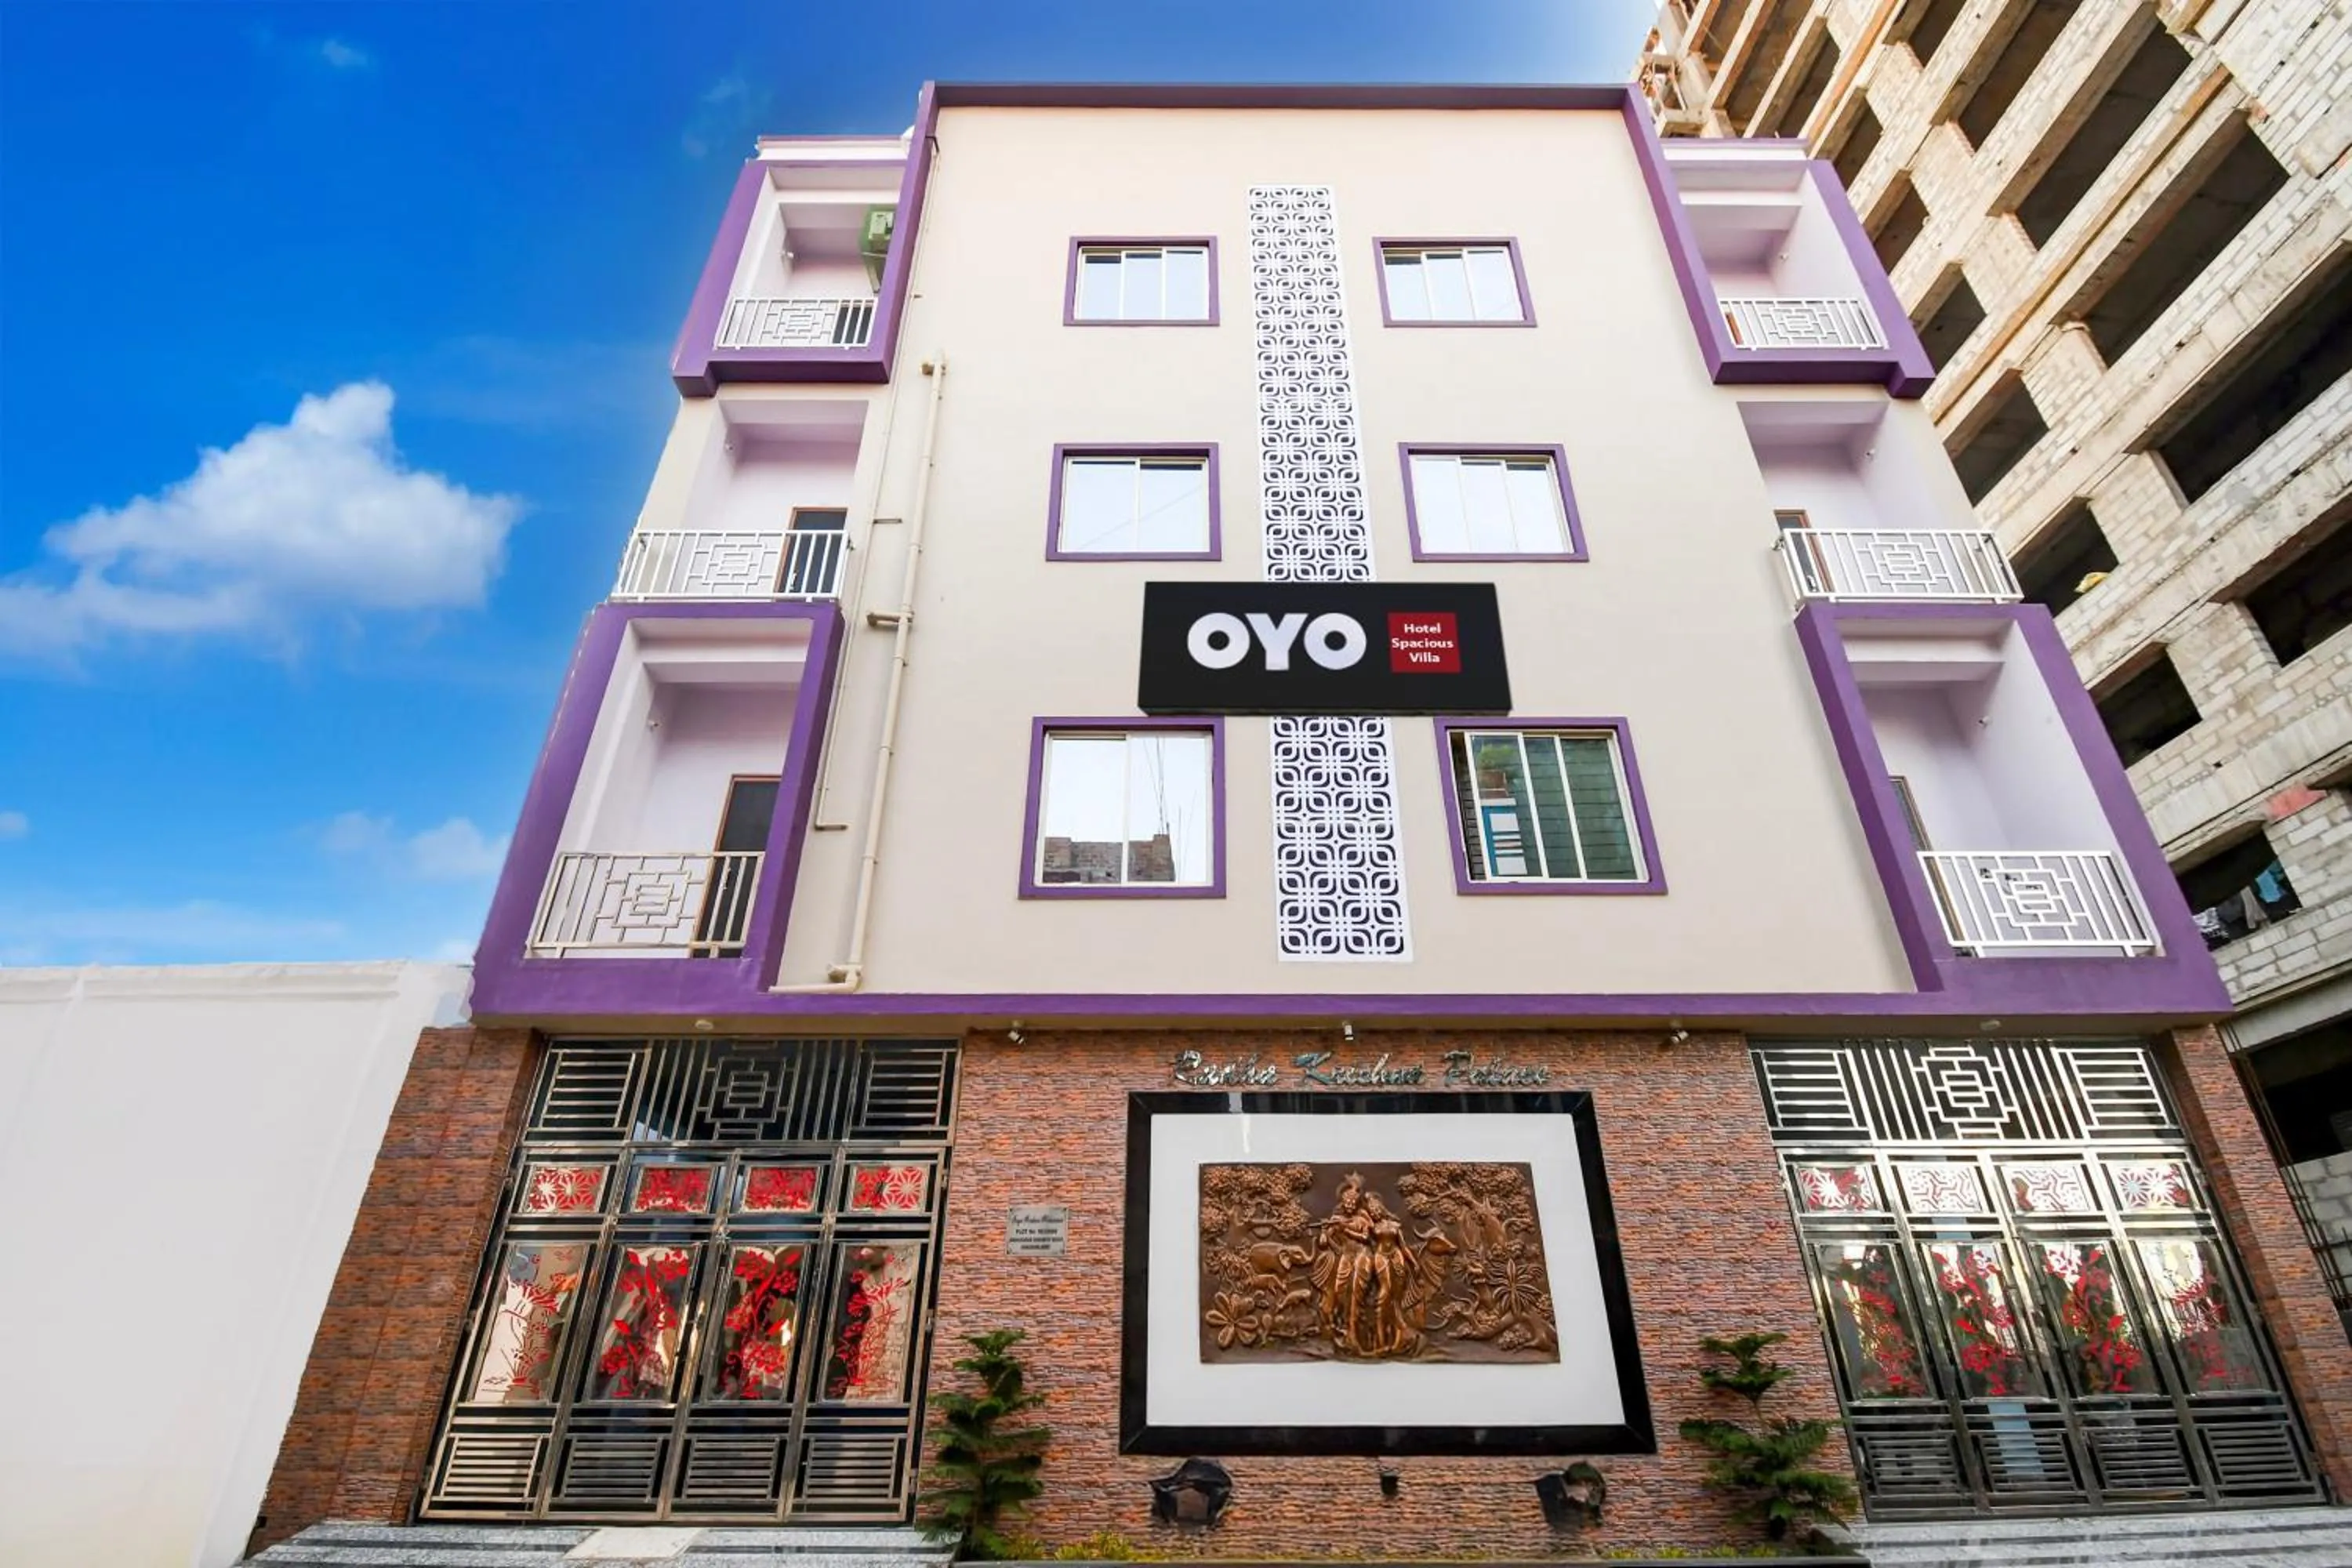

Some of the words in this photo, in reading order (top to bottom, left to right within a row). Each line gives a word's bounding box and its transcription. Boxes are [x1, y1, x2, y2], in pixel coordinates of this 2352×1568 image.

[1404, 622, 1441, 633] Hotel
[1187, 612, 1367, 670] OYO
[1392, 637, 1454, 650] Spacious
[1409, 652, 1440, 662] Villa
